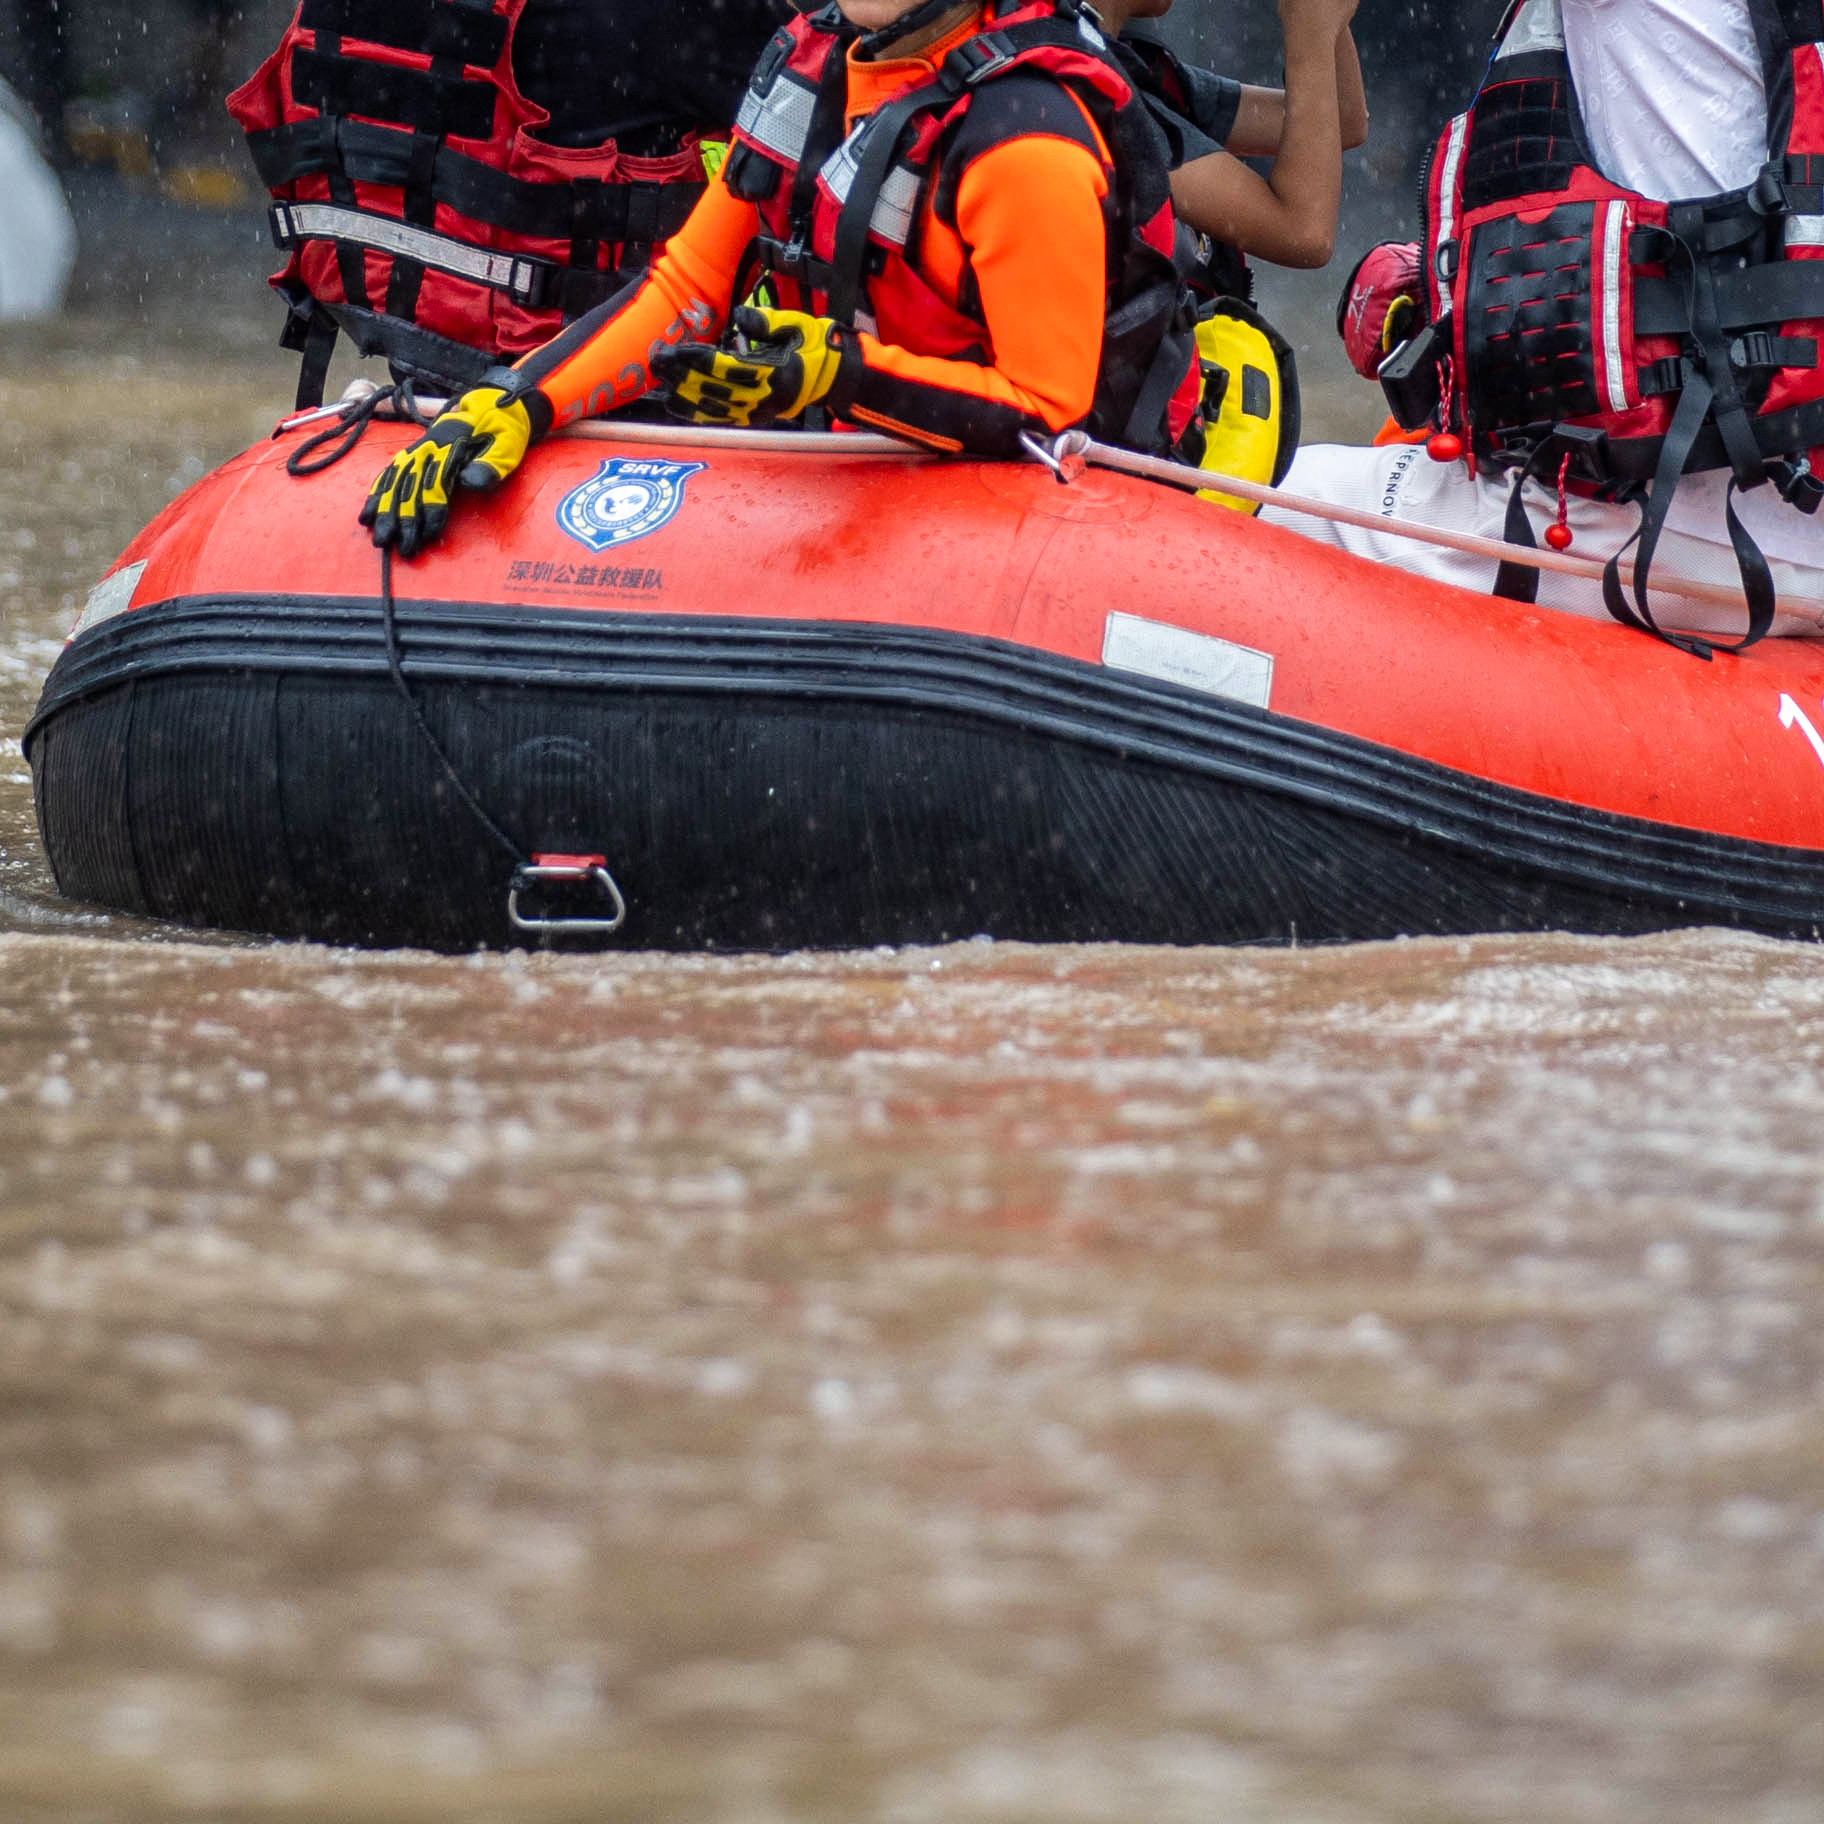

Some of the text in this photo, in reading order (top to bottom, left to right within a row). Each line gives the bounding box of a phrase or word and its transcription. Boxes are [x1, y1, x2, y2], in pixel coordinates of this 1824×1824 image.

[618, 462, 682, 476] SRVF
[508, 560, 663, 590] 深圳公益救援队
